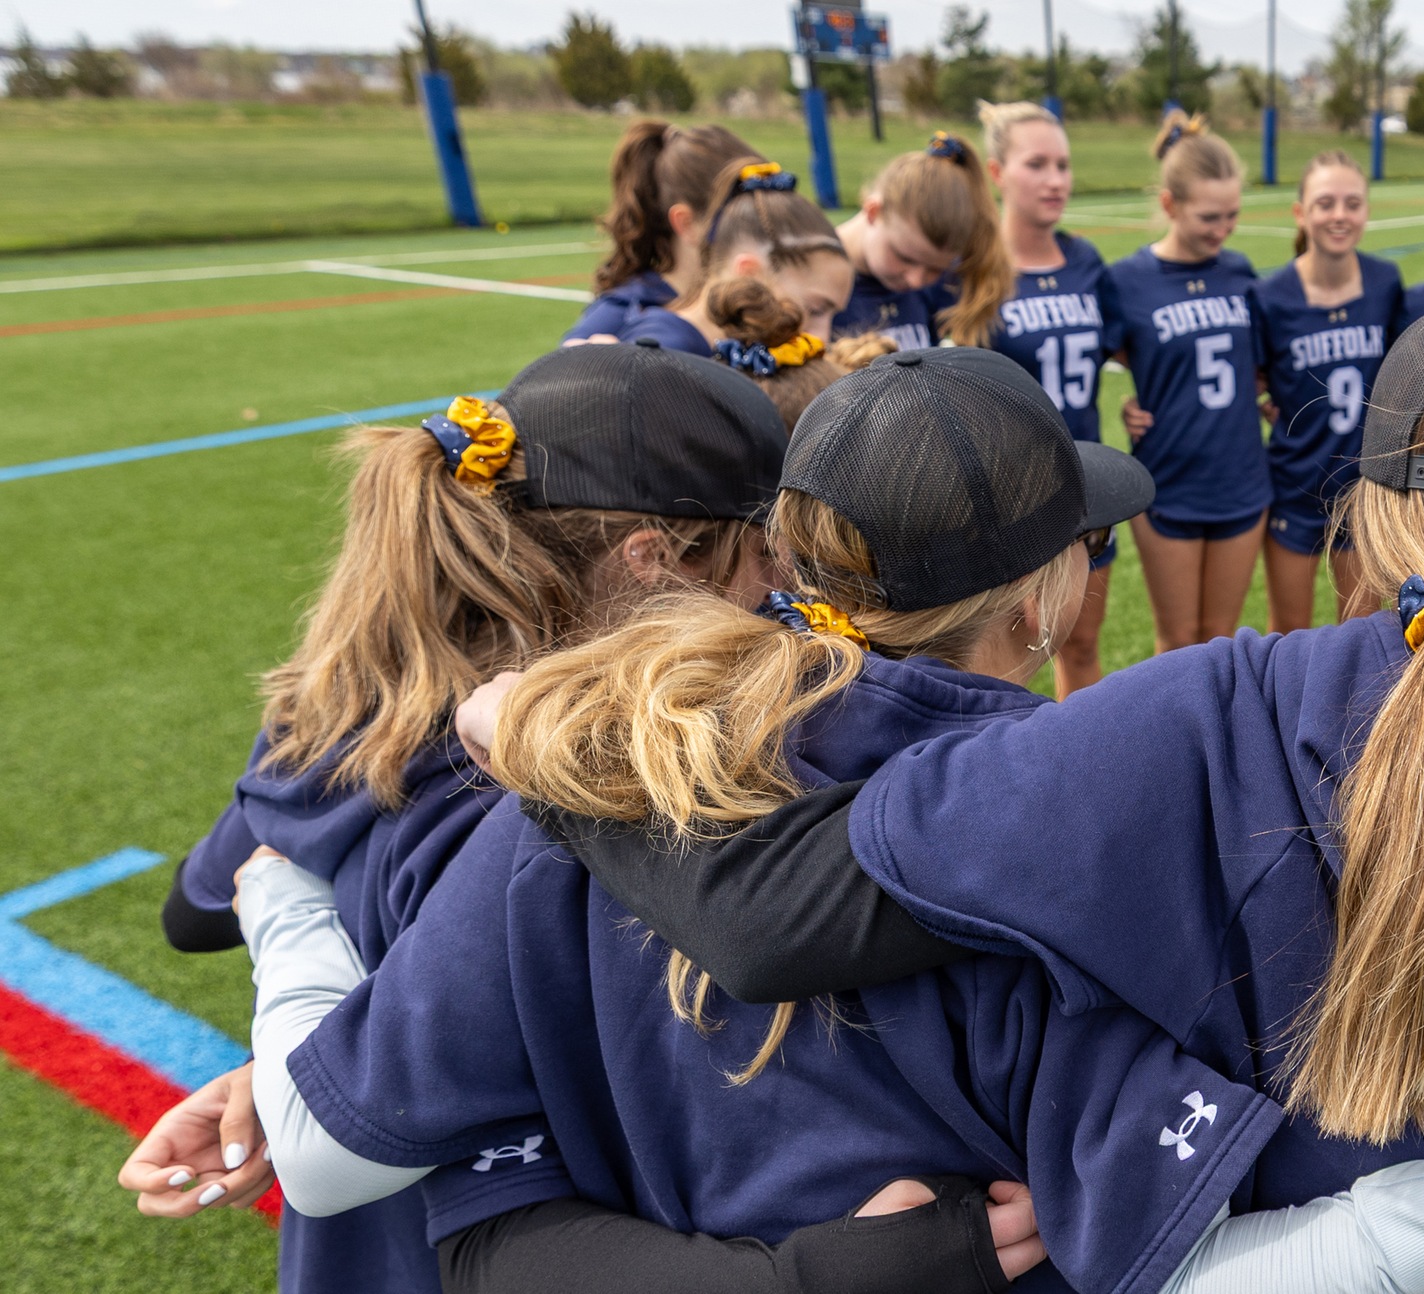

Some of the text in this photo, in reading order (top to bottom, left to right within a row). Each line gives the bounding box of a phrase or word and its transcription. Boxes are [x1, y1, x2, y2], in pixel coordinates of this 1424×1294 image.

[1001, 293, 1103, 338] SUFFOLK
[1152, 295, 1251, 344] SUFFOLK
[1035, 331, 1099, 411] 15
[1195, 333, 1236, 410] 5
[1290, 325, 1384, 371] SUFFOLK
[1326, 366, 1364, 435] 9
